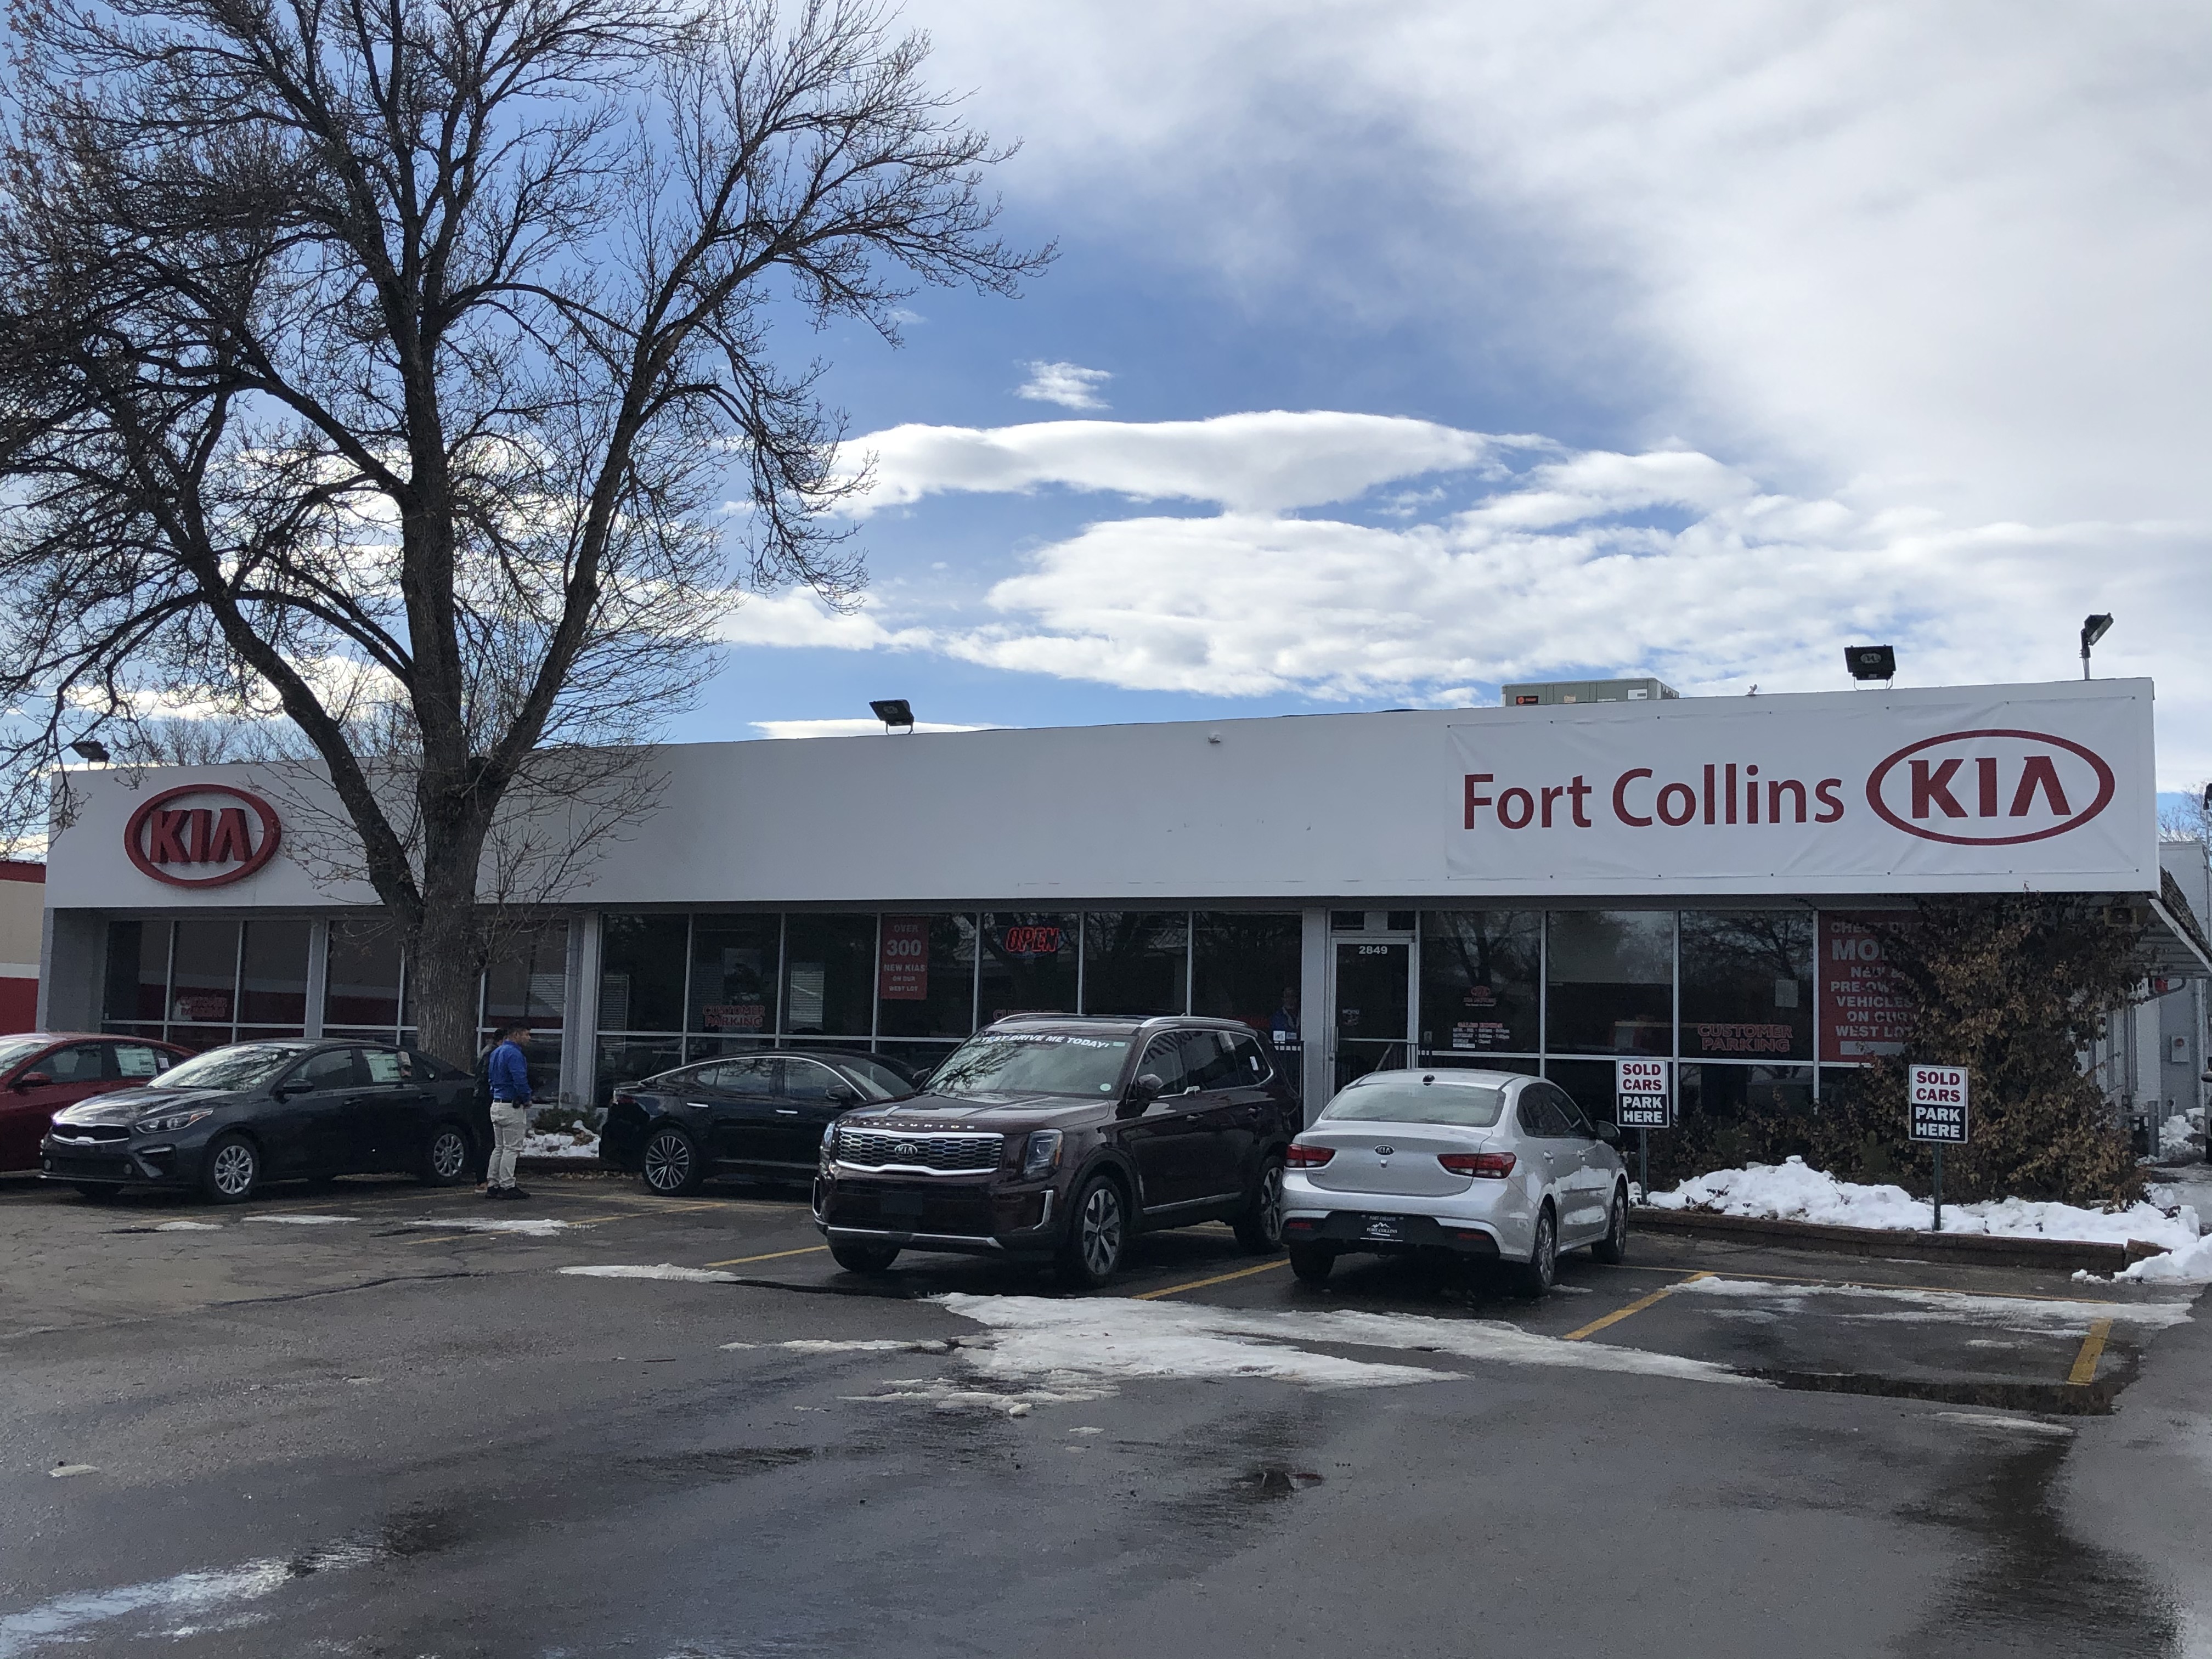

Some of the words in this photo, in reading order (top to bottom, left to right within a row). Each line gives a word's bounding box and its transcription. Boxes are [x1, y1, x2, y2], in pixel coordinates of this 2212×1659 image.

[1464, 773, 1592, 830] Fort
[1612, 763, 1845, 827] Collins
[1908, 755, 2072, 819] KIA
[149, 807, 253, 864] KIA
[894, 924, 918, 933] OVER
[1006, 927, 1060, 952] OPEN
[887, 939, 922, 956] 300
[1358, 945, 1387, 955] 2849
[905, 964, 926, 972] KIAS
[1835, 996, 1914, 1008] VEHICLES
[703, 1005, 766, 1017] CUSTOMER
[1847, 1011, 1869, 1022] ON
[705, 1016, 763, 1028] PARKING
[1697, 1024, 1793, 1038] CUSTOMER
[1835, 1025, 1879, 1037] WEST
[980, 1035, 1009, 1043] TEST
[1066, 1037, 1109, 1048] TODAY!
[1702, 1038, 1790, 1052] PARKING
[1622, 1064, 1661, 1075] SOLD
[1916, 1071, 1960, 1085] SOLD
[1622, 1079, 1662, 1091] CARS
[1916, 1088, 1961, 1102] CARS
[1622, 1096, 1663, 1108] PARK
[1623, 1110, 1663, 1123] HERE
[1916, 1107, 1961, 1122] PARK
[1916, 1122, 1960, 1138] HERE
[898, 1147, 913, 1155] KIA
